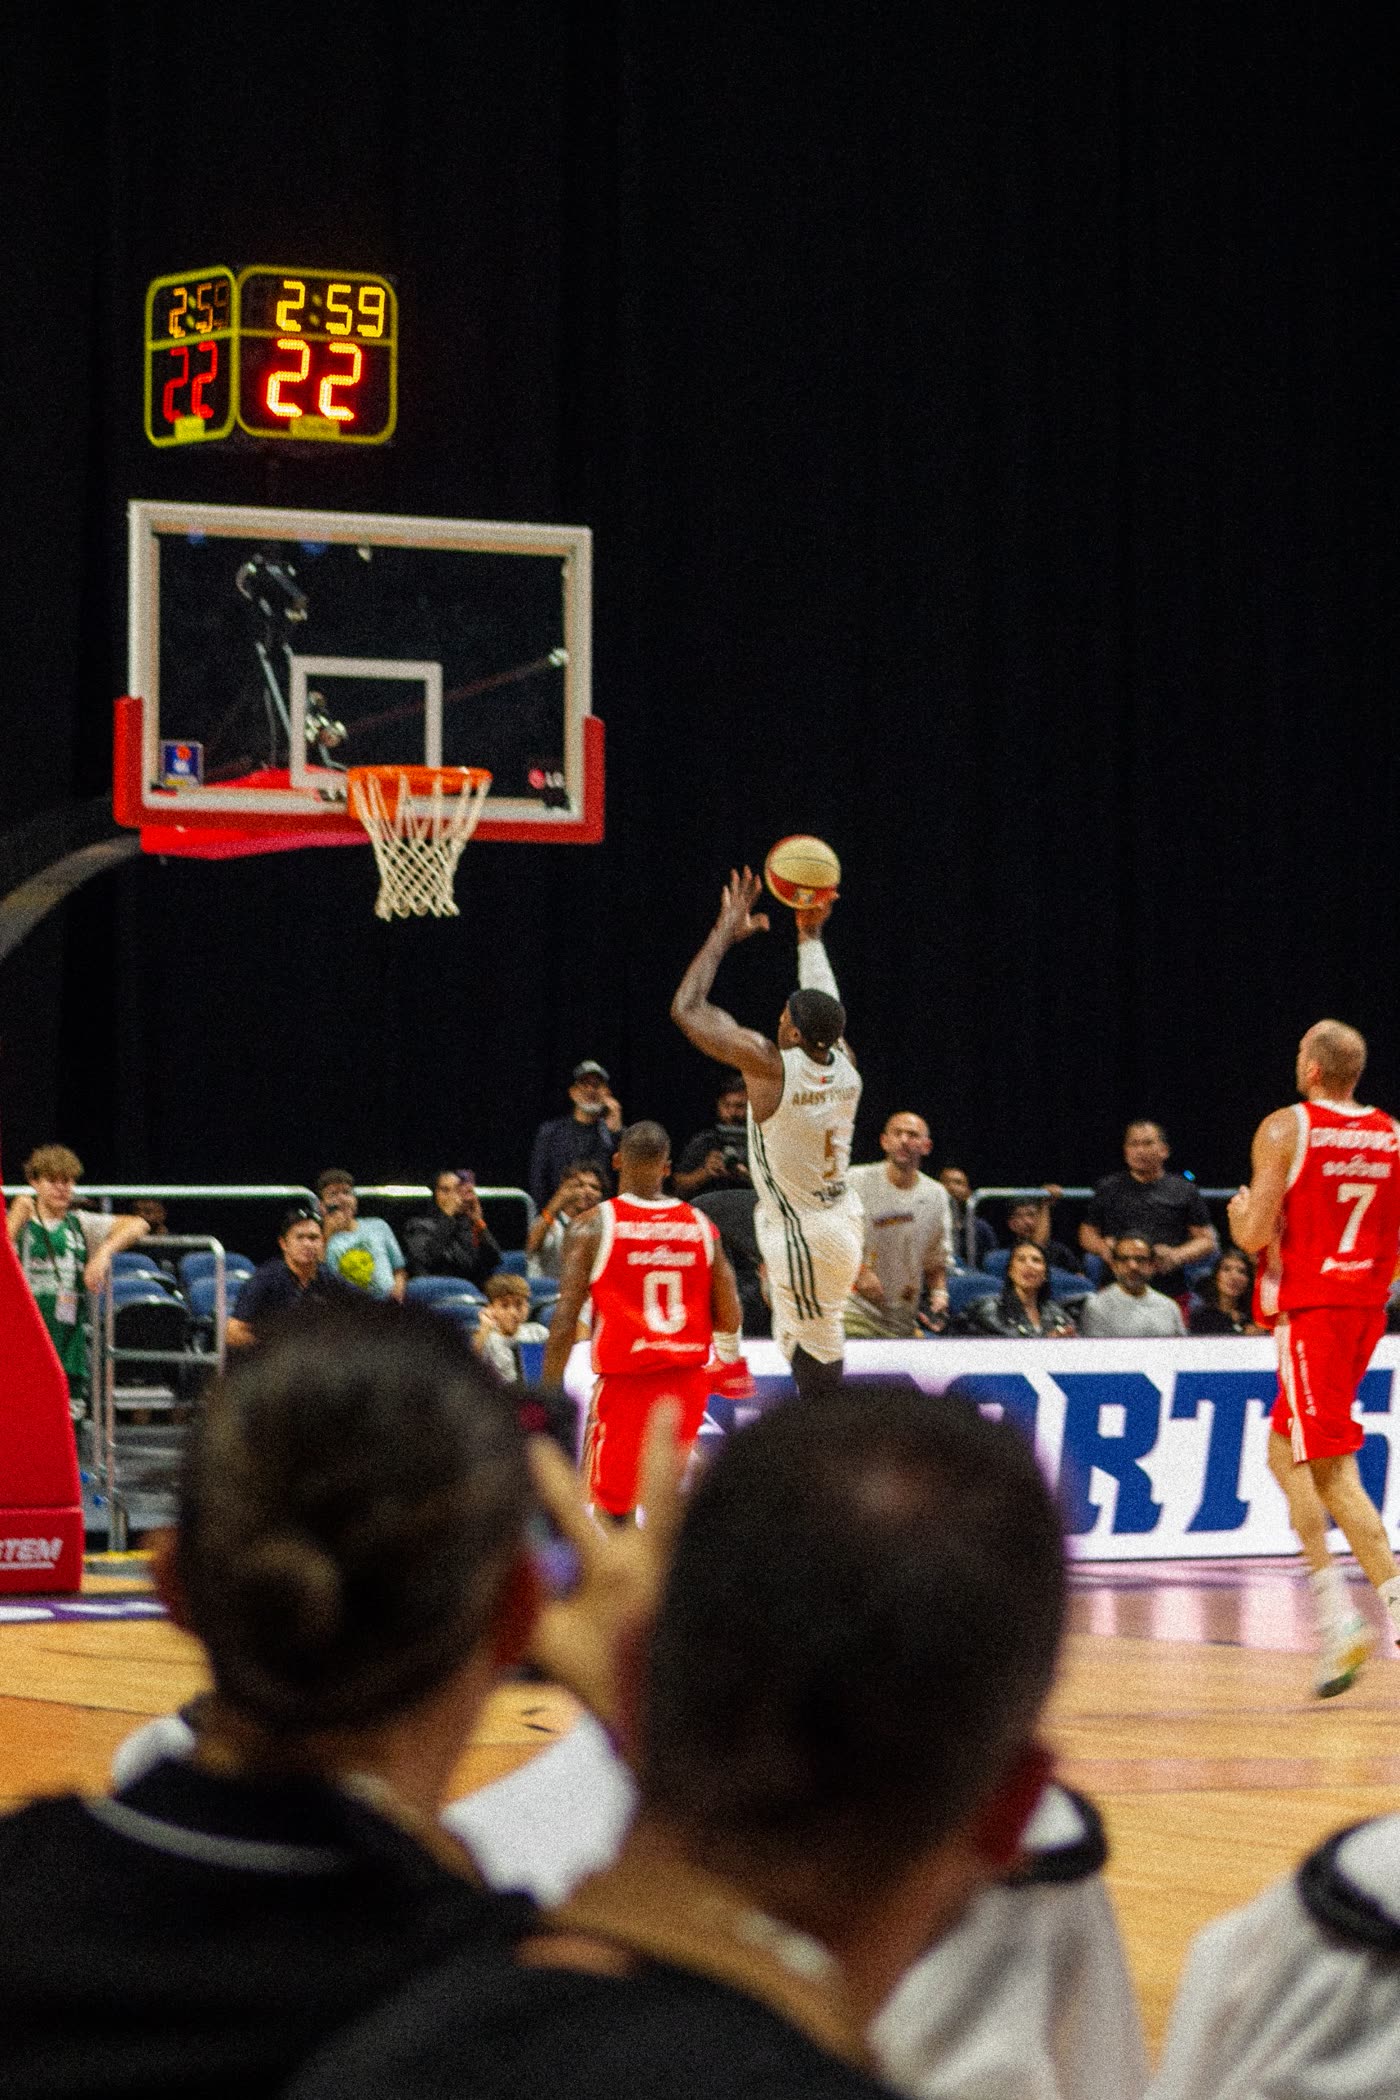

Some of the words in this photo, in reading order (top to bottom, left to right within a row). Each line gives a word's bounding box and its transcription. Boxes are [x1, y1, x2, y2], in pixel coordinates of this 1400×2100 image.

[276, 281, 385, 337] 2:59
[163, 341, 218, 422] 22
[266, 339, 362, 421] 22
[1336, 1183, 1377, 1254] 7
[643, 1270, 687, 1334] 0
